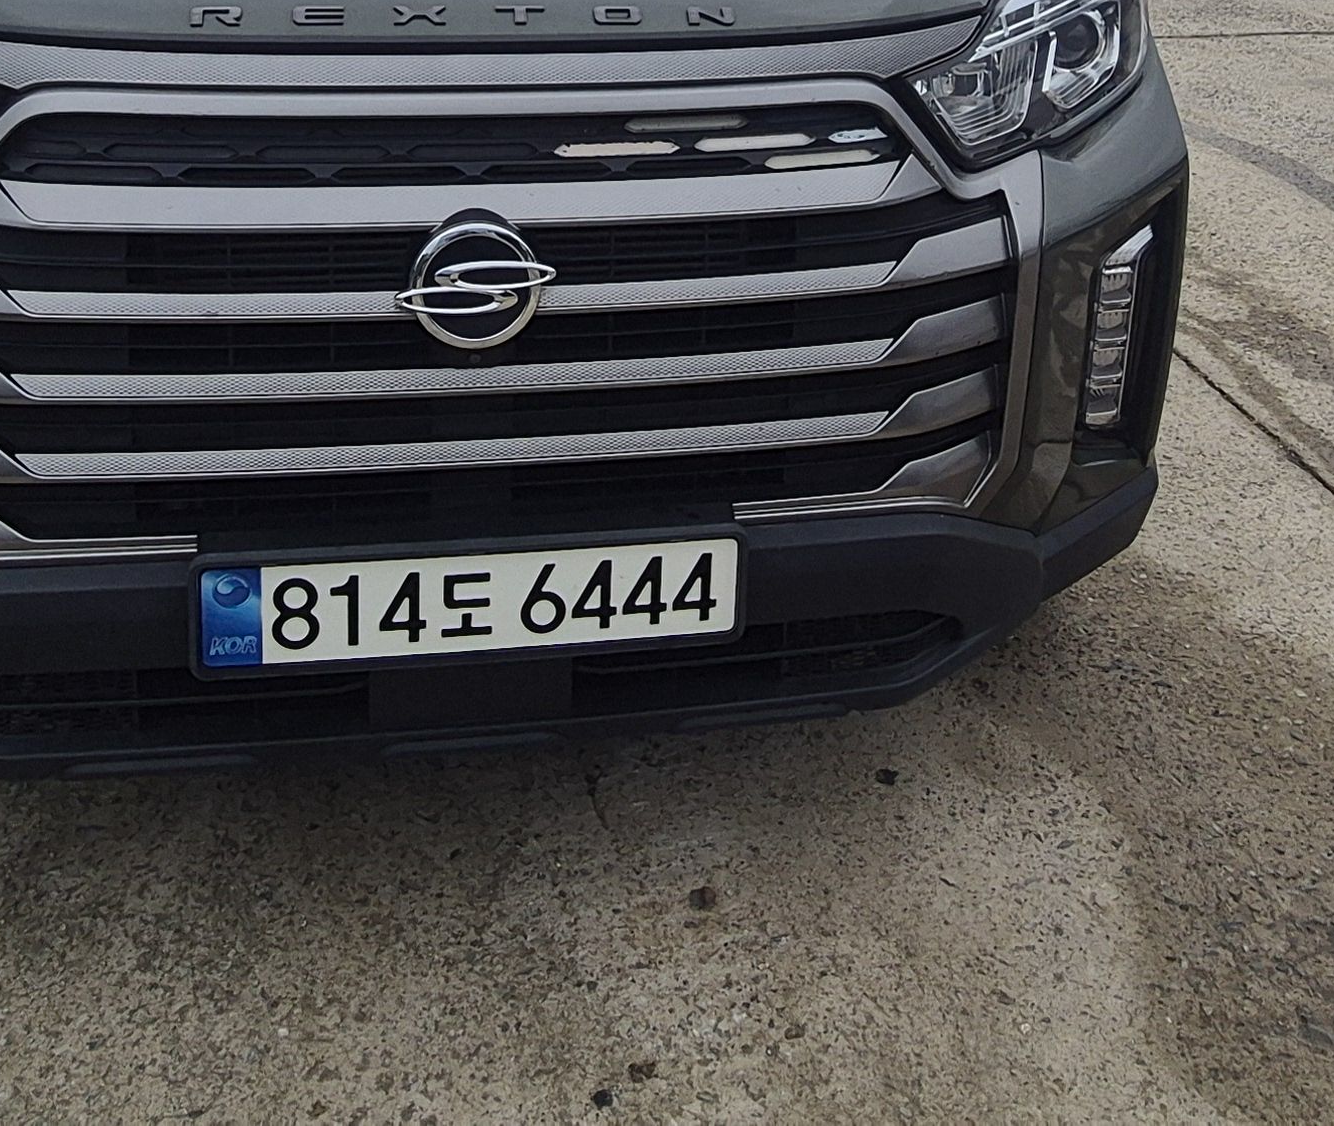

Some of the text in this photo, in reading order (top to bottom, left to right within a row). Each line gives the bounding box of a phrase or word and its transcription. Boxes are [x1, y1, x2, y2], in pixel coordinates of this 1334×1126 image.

[189, 4, 736, 28] REXTON
[271, 552, 716, 650] 814도 6444
[209, 635, 258, 656] KOR
